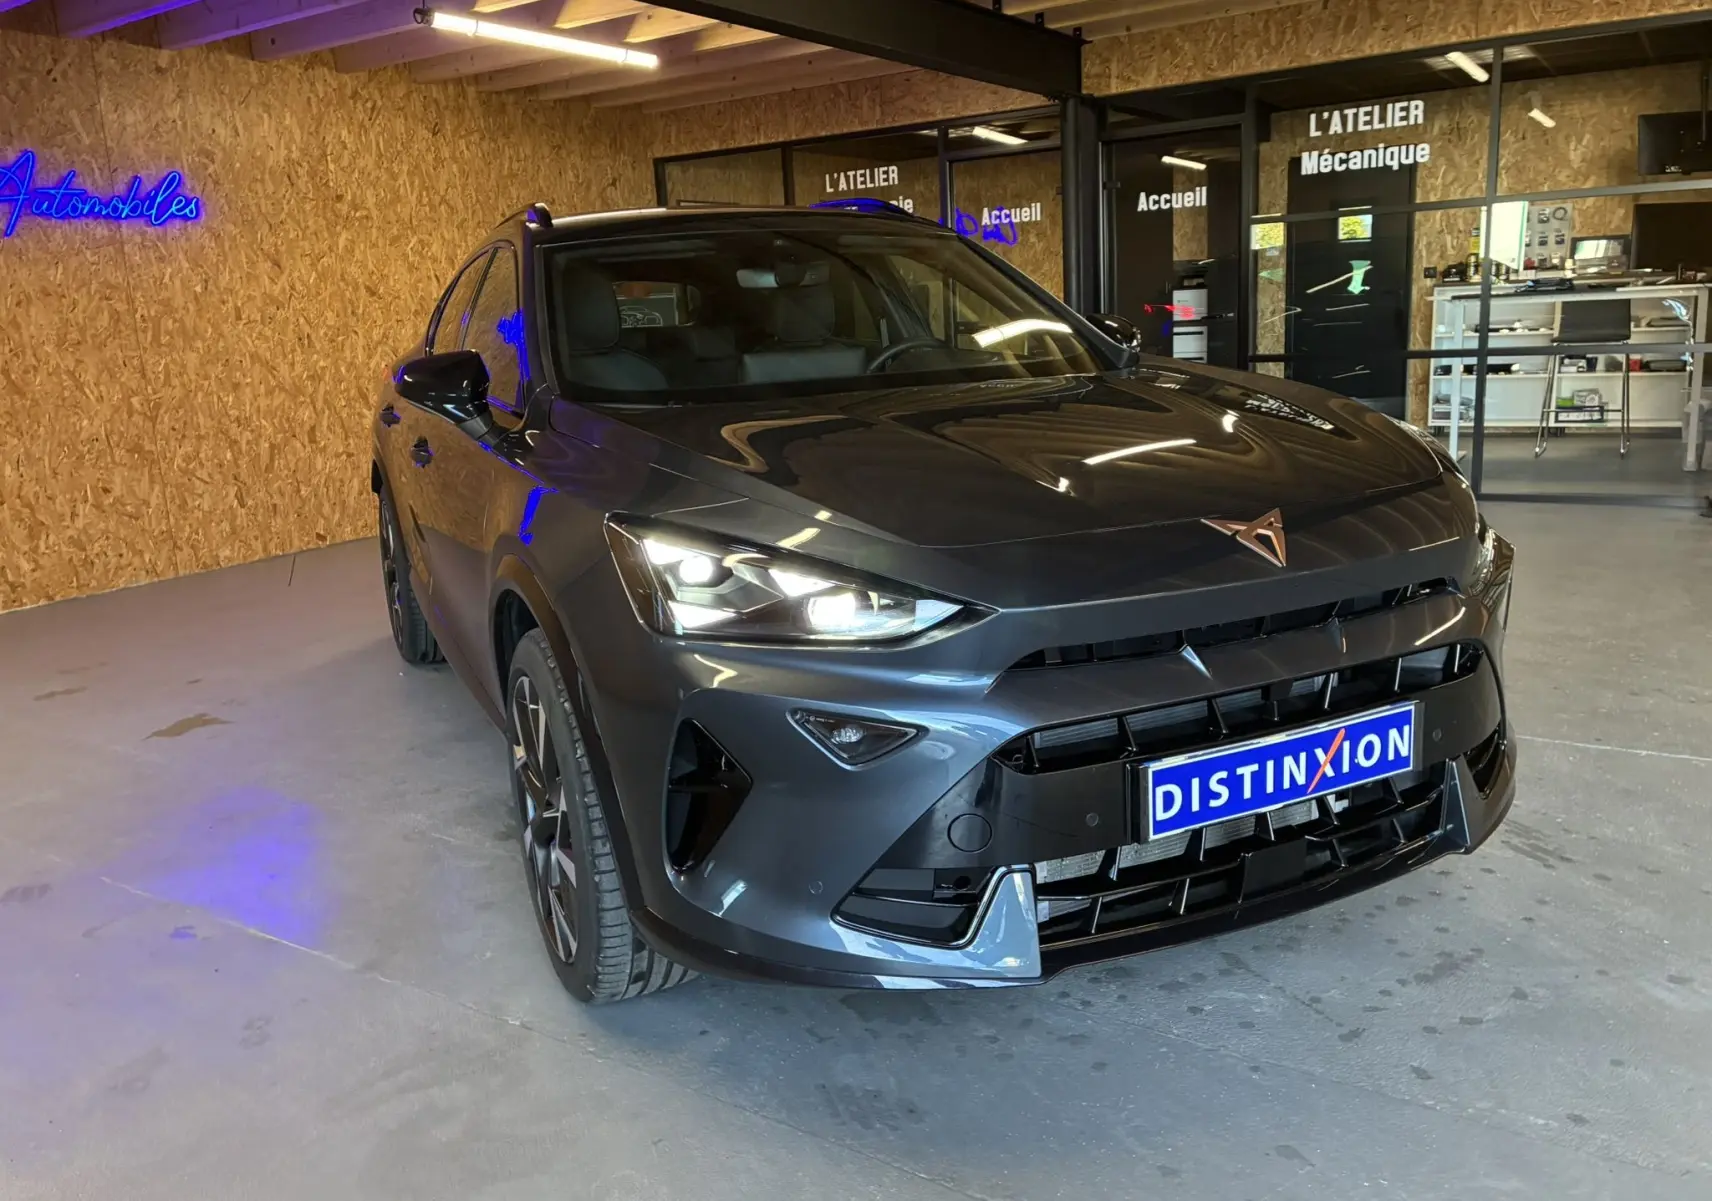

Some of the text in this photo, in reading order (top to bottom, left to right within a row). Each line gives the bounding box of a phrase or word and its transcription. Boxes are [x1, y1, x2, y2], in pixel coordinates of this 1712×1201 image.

[1309, 99, 1424, 137] L'ATELIER
[1300, 142, 1430, 175] Mécanique
[0, 150, 200, 237] Automobiles
[825, 165, 899, 193] L'ATELIER
[981, 202, 1042, 226] Accueil
[1137, 186, 1207, 212] Accueil
[1155, 724, 1410, 821] DISTINXION
